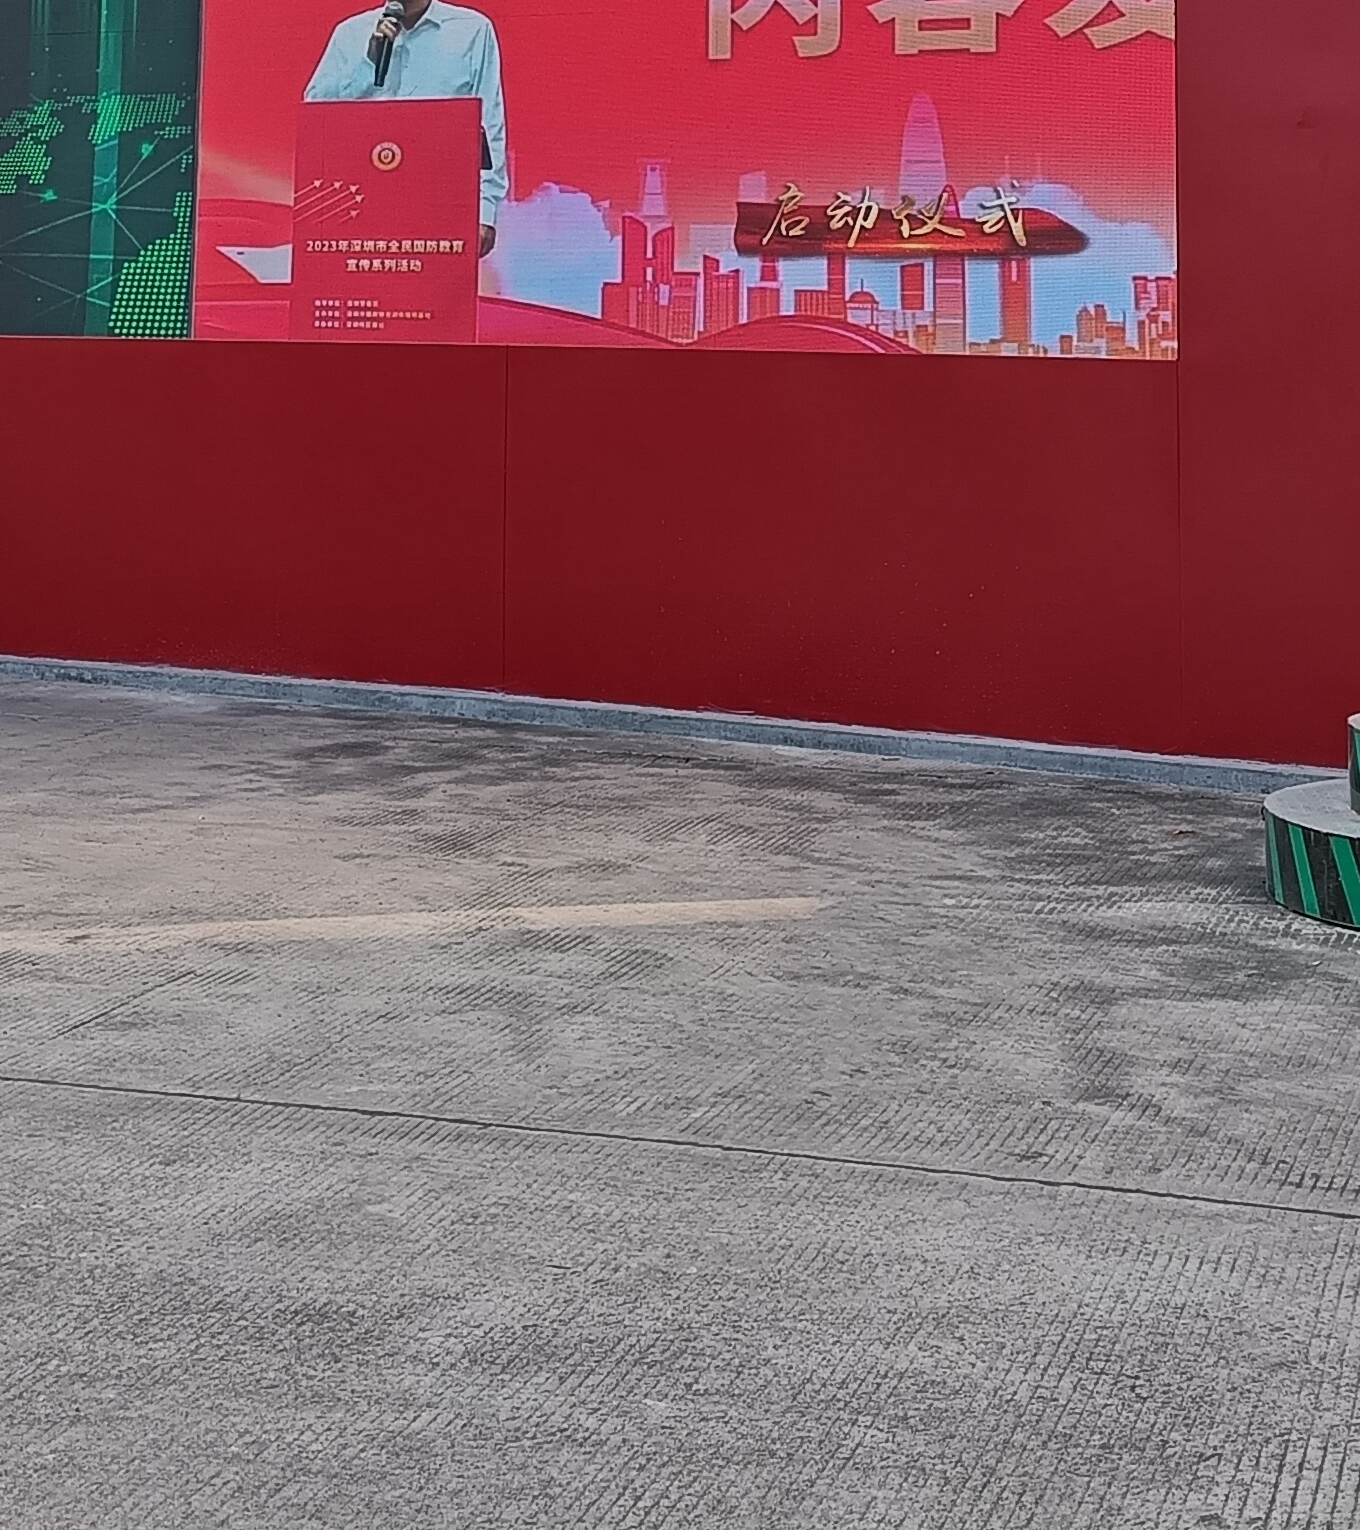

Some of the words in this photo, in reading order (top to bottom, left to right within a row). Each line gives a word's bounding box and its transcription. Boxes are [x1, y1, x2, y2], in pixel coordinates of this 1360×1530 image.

[762, 180, 1027, 247] 启动仪式
[306, 240, 464, 253] 2023年深圳市全民国防教育
